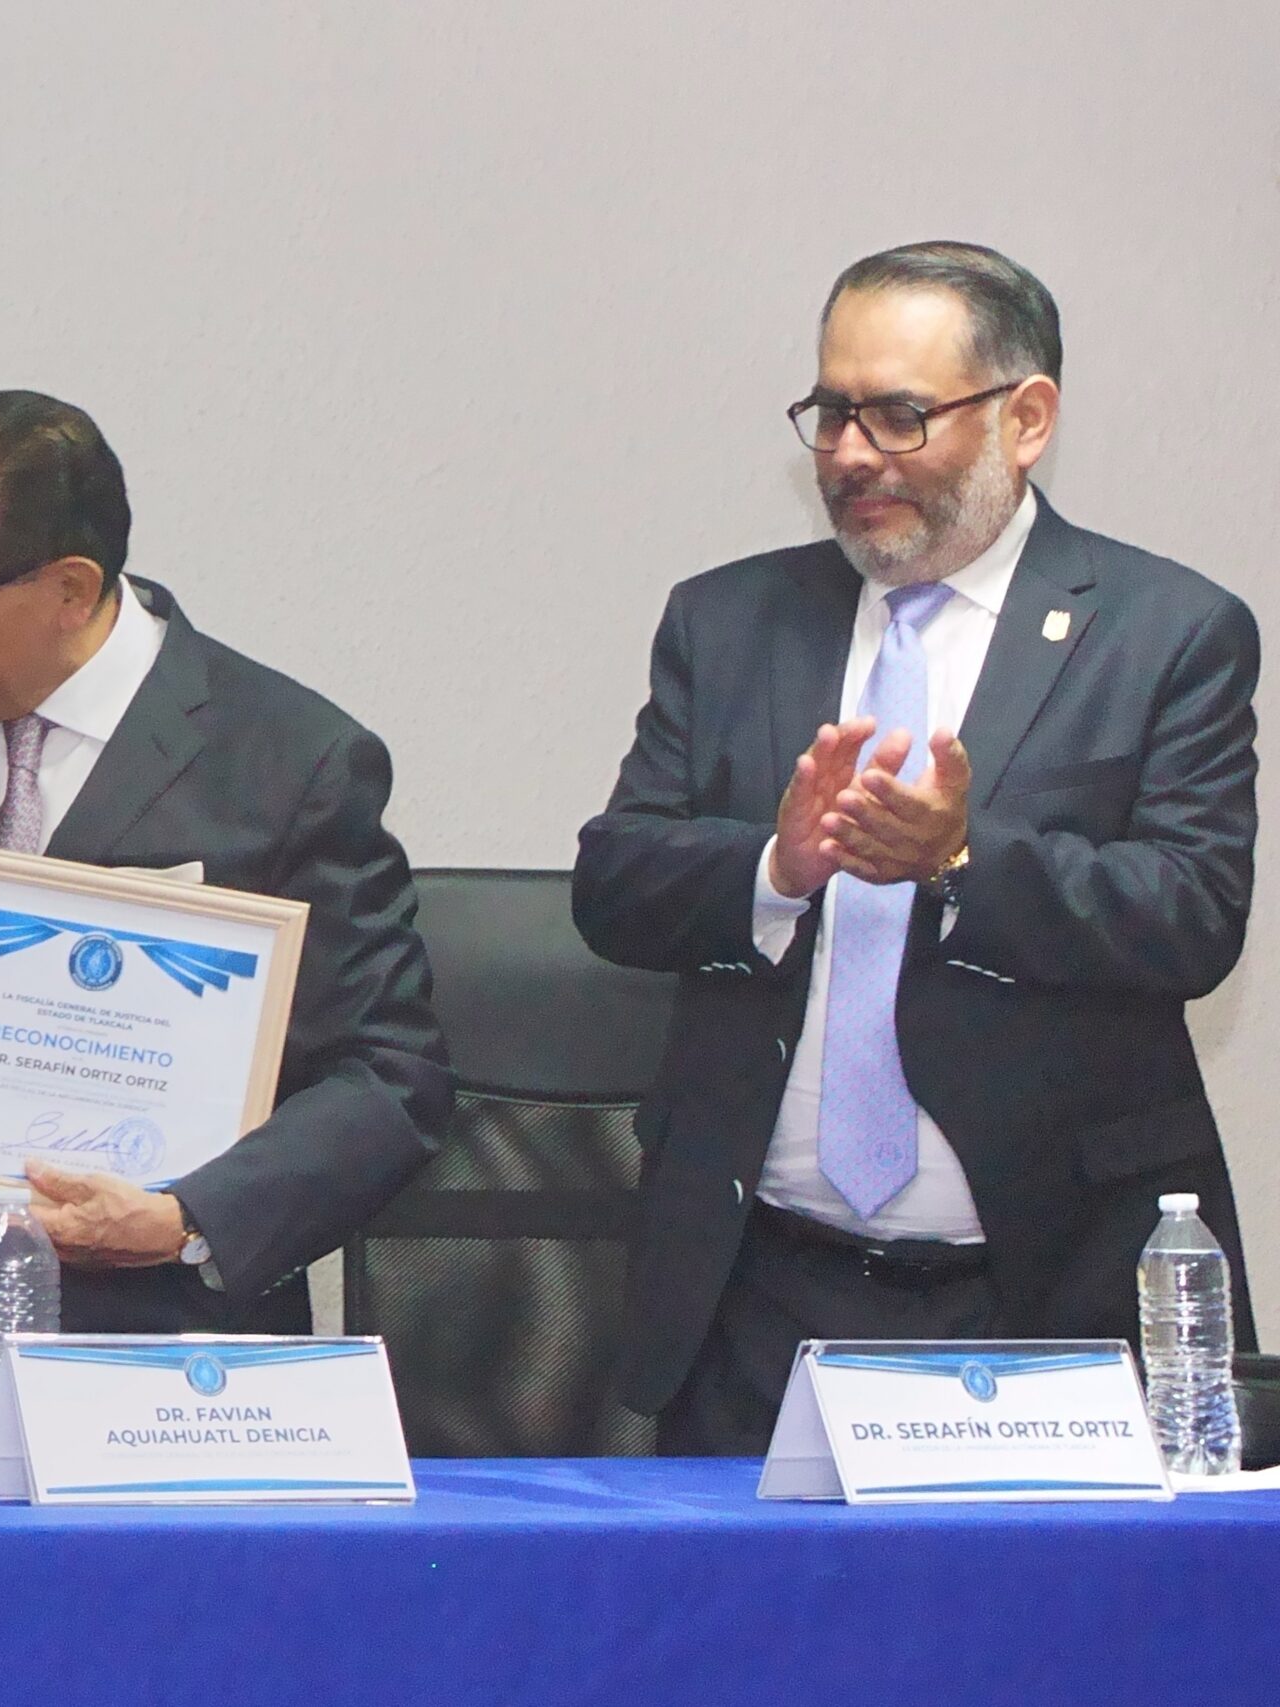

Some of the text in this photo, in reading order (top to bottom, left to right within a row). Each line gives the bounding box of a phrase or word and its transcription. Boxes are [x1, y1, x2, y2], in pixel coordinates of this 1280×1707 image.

[2, 992, 13, 1000] LA
[57, 1001, 97, 1015] GENERAL
[99, 1009, 111, 1017] DE
[114, 1010, 152, 1024] JUSTICIA
[155, 1018, 171, 1028] DEL
[37, 1008, 72, 1020] ESTADO
[74, 1015, 85, 1023] DE
[89, 1017, 133, 1031] TLAXCALA
[15, 1055, 76, 1077] SERAFÍN
[80, 1067, 122, 1085] ORTIZ
[125, 1075, 169, 1092] ORTIZ
[156, 1407, 273, 1423] DR. FAVIAN
[106, 1427, 331, 1447] AQUIAHUATL DENICIA
[851, 1417, 1134, 1441] DR. SERAFÍN ORTIZ ORTIZ
